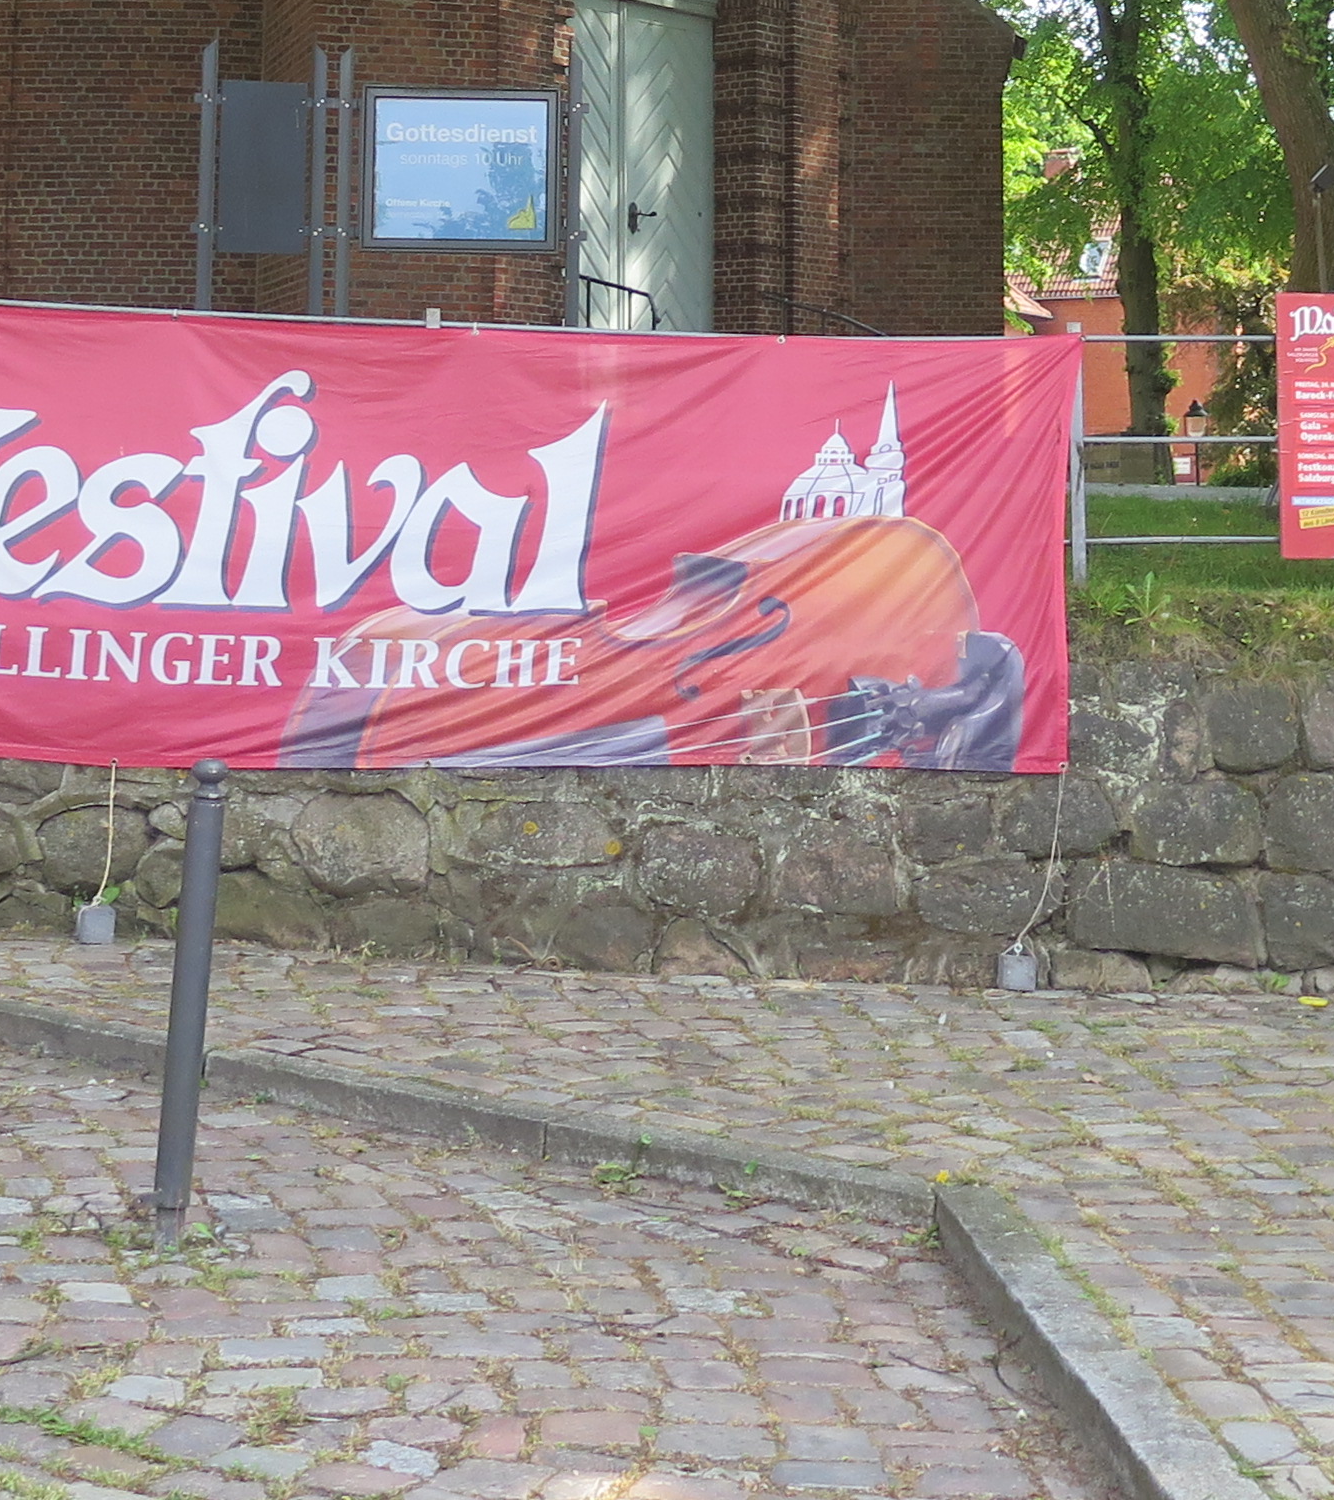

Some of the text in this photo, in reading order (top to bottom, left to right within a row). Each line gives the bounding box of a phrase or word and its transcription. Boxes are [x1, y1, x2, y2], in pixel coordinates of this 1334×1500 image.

[386, 122, 537, 143] Gottesdienst
[400, 152, 524, 166] sonntags 10 Uhr
[1300, 421, 1321, 430] Gala
[306, 635, 583, 690] KIRCHE
